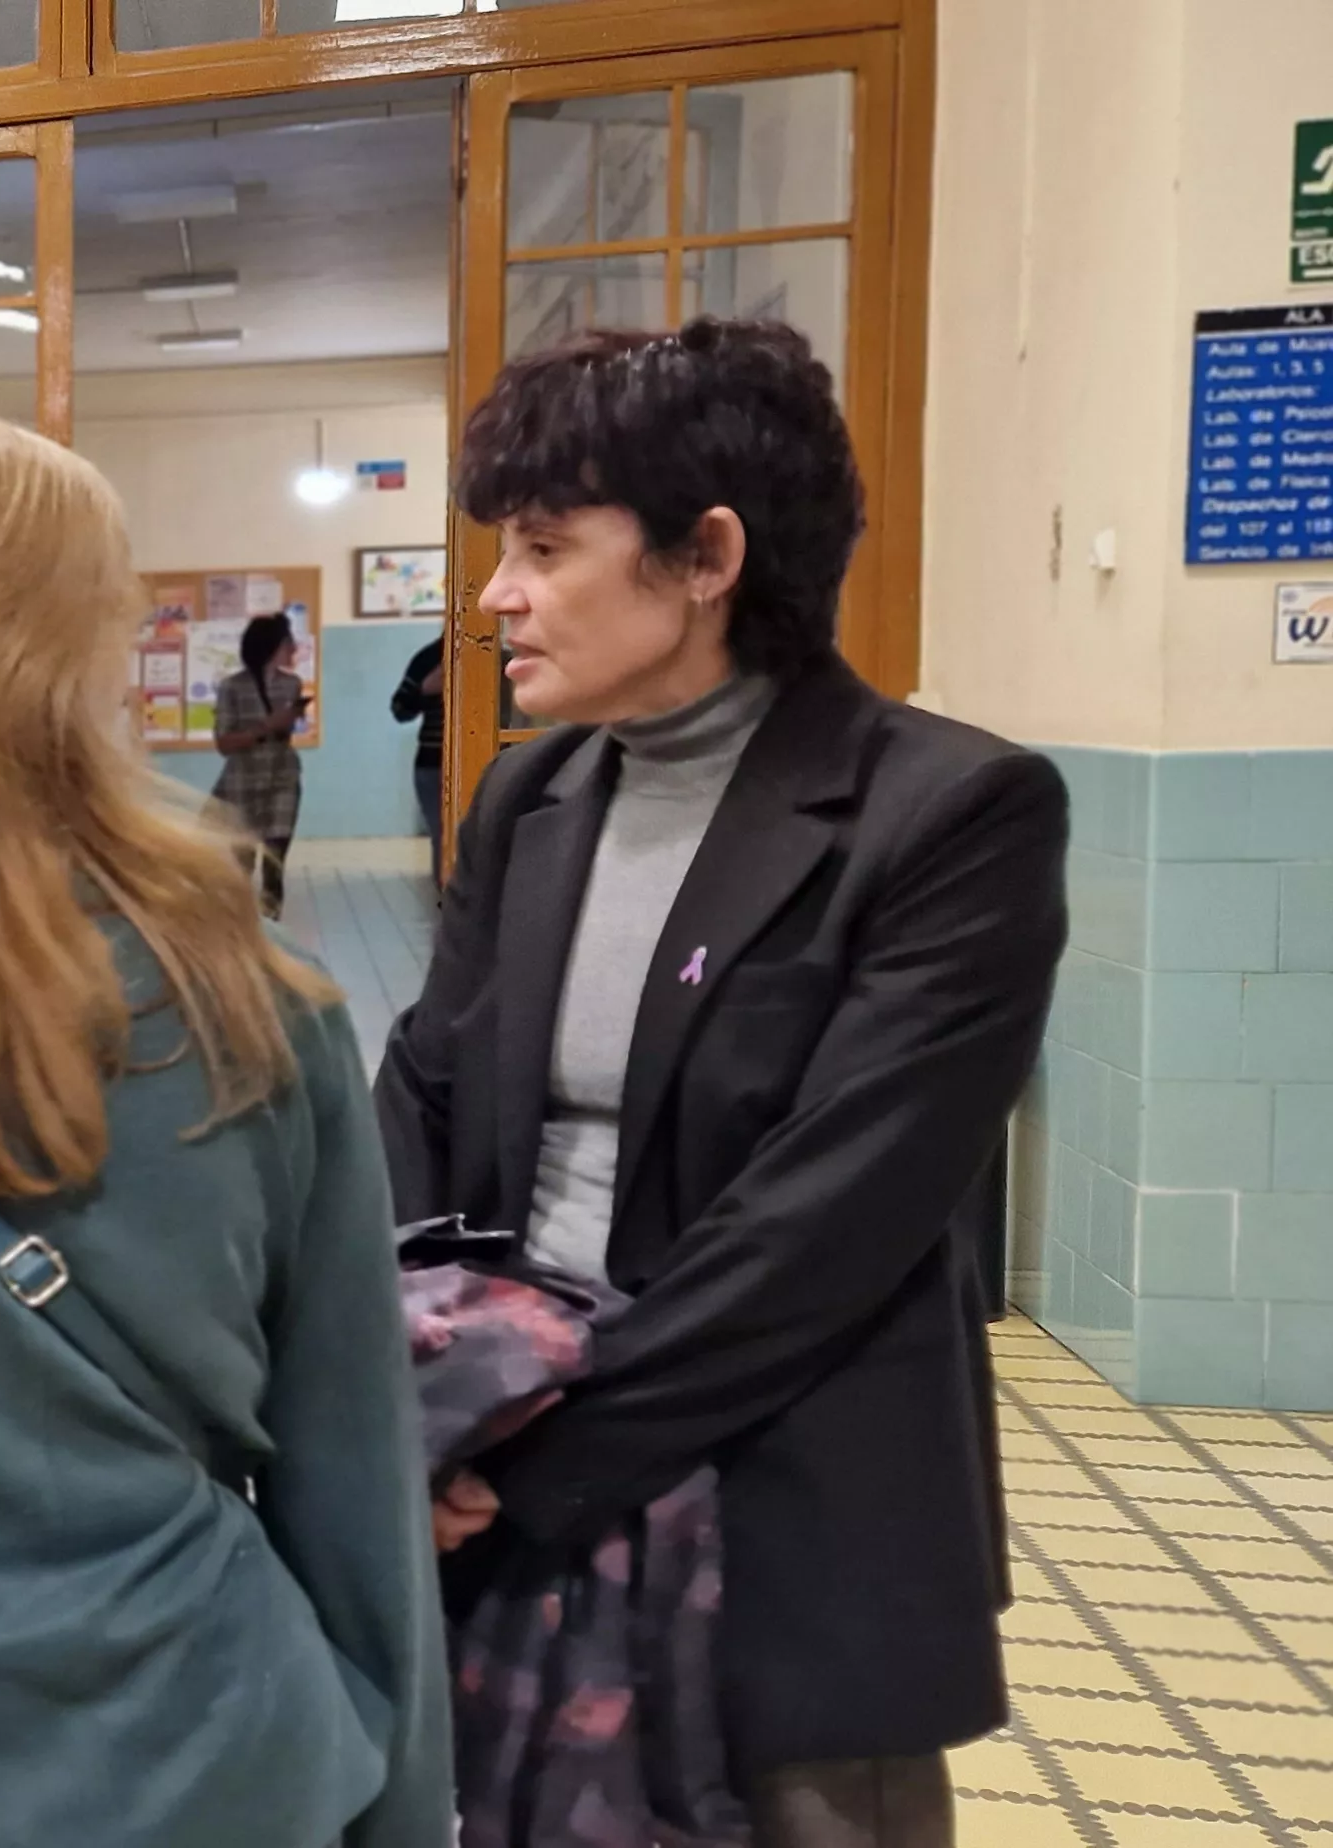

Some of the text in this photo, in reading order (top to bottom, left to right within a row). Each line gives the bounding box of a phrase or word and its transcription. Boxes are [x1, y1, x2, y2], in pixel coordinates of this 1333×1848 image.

[1284, 309, 1325, 324] ALA
[1208, 342, 1247, 356] Aula
[1255, 341, 1279, 354] de
[1249, 409, 1274, 424] de
[1249, 432, 1274, 447] de
[1248, 454, 1273, 469] de
[1246, 476, 1271, 492] de
[1202, 496, 1332, 515] Despachos de
[1198, 522, 1227, 538] del
[1276, 520, 1293, 536] al
[1198, 545, 1269, 561] Servicio
[1276, 544, 1300, 558] de
